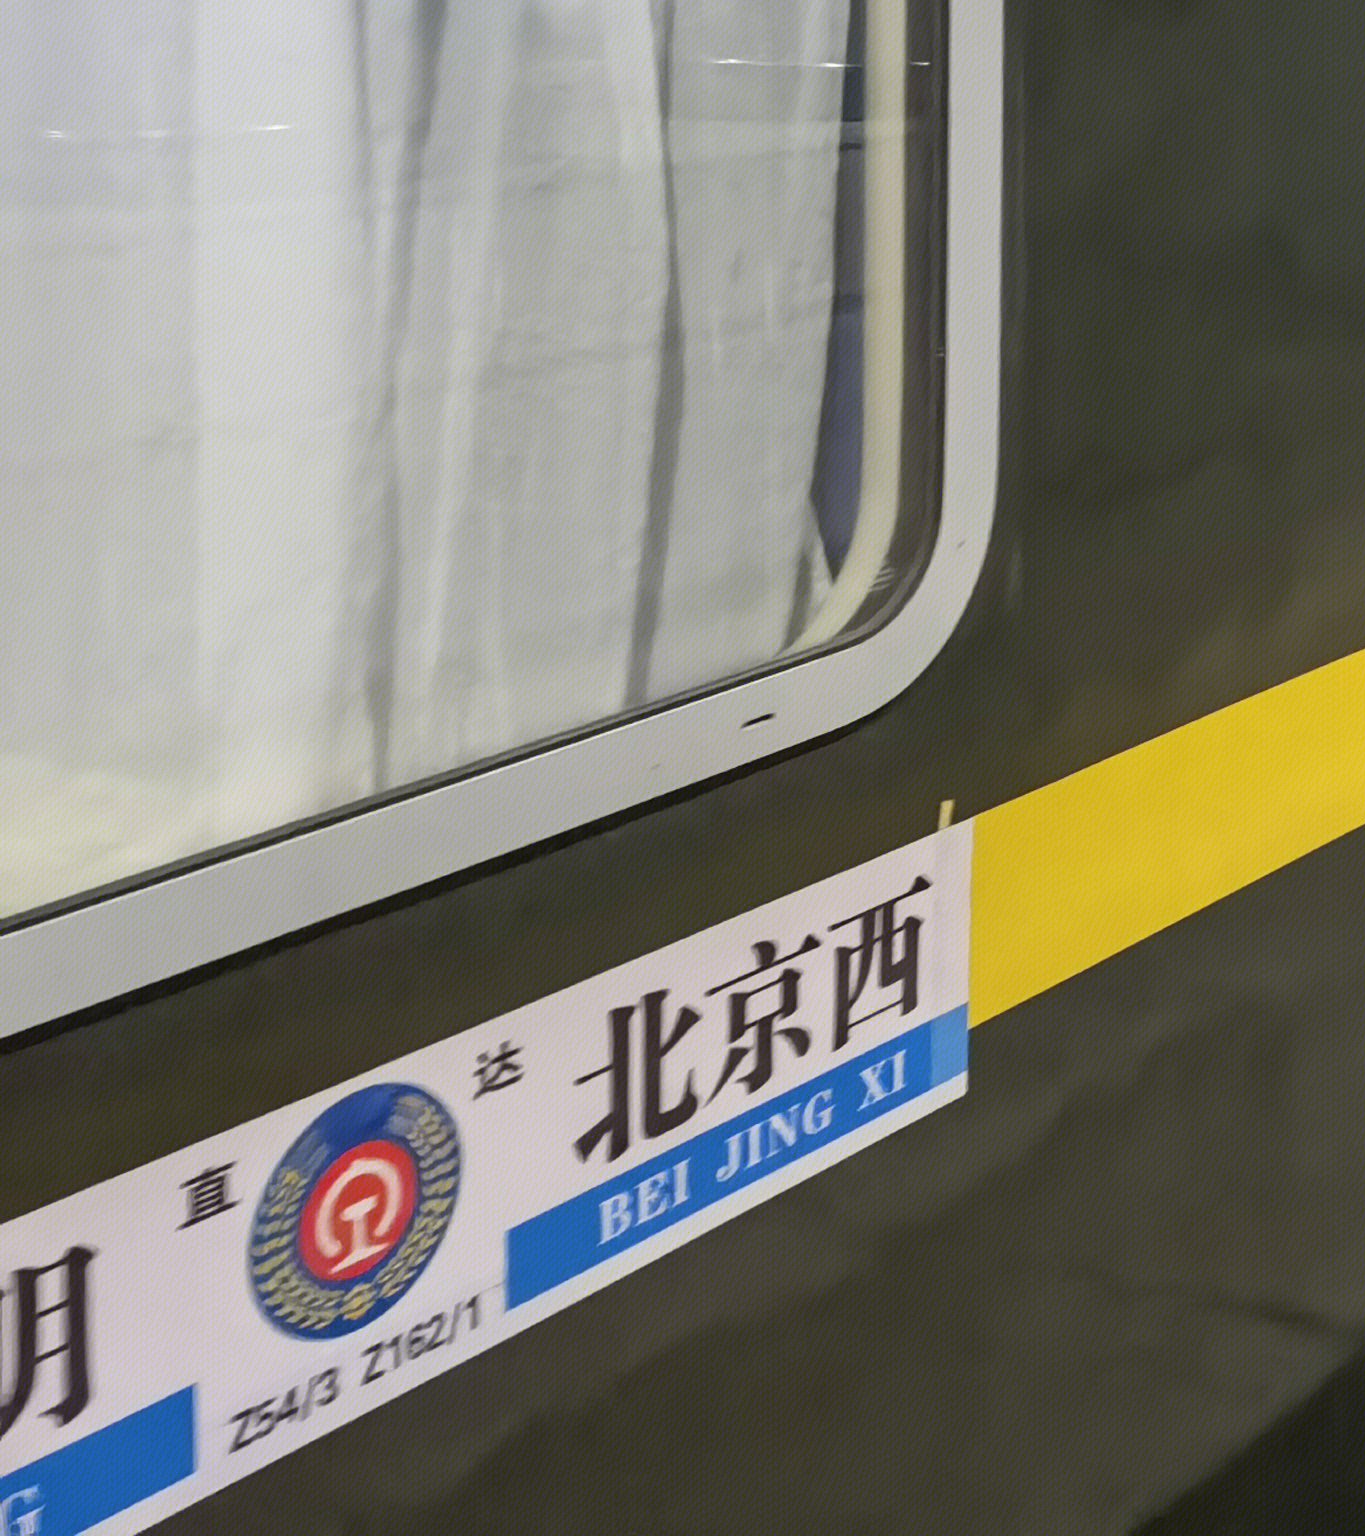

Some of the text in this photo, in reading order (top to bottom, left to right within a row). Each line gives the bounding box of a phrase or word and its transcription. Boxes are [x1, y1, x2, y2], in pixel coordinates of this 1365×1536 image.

[572, 876, 933, 1164] 北京西
[174, 1040, 524, 1232] 直 达
[597, 1049, 908, 1247] BEI JING XI
[226, 1293, 482, 1454] Z54/3 Z162/1
